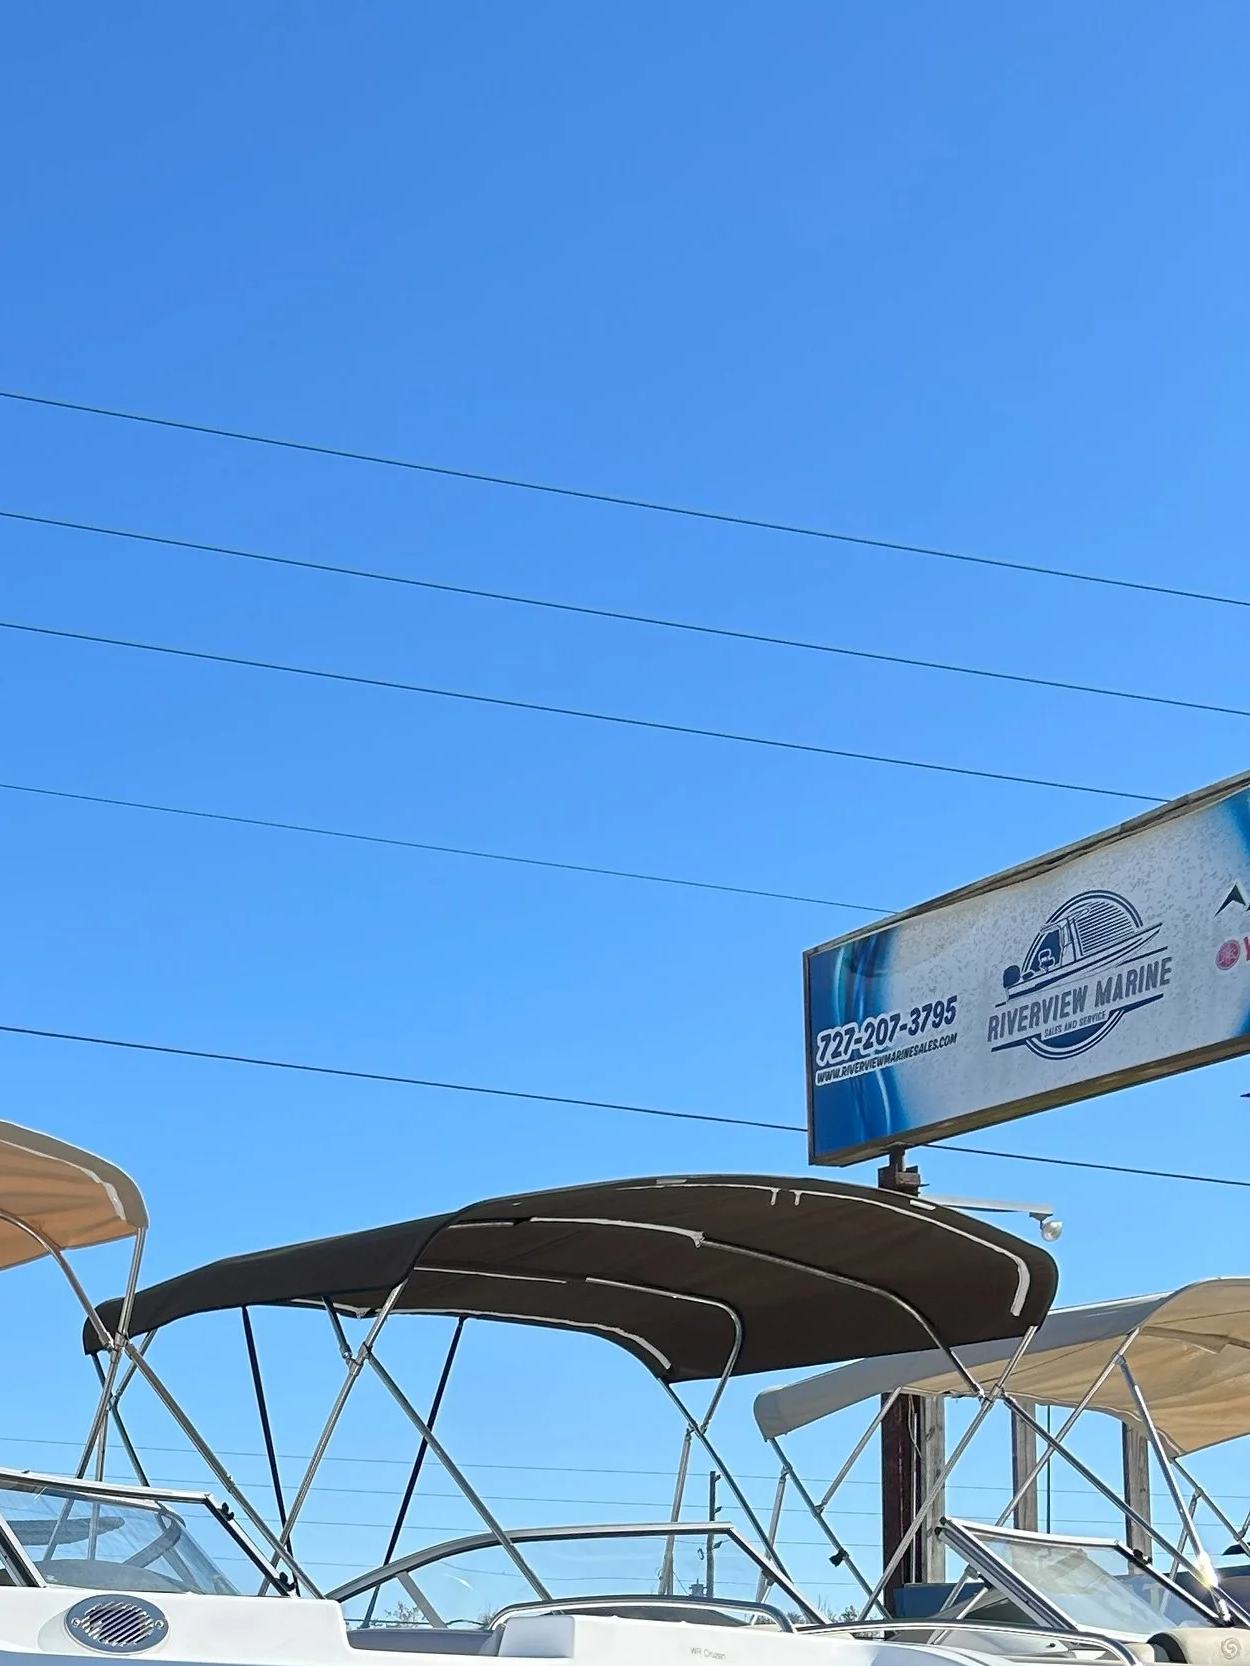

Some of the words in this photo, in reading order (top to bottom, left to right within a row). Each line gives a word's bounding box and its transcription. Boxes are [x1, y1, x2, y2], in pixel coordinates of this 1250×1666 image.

[820, 995, 958, 1062] 727-207-3795
[987, 985, 1089, 1042] RIVERVIEW
[1094, 957, 1173, 1008] MARINE
[1044, 1023, 1063, 1037] SALES
[1063, 1018, 1078, 1032] AND
[1079, 1010, 1107, 1029] SERVICE
[816, 1032, 958, 1084] WWW.RIVERVIEWMARINESALES.COM
